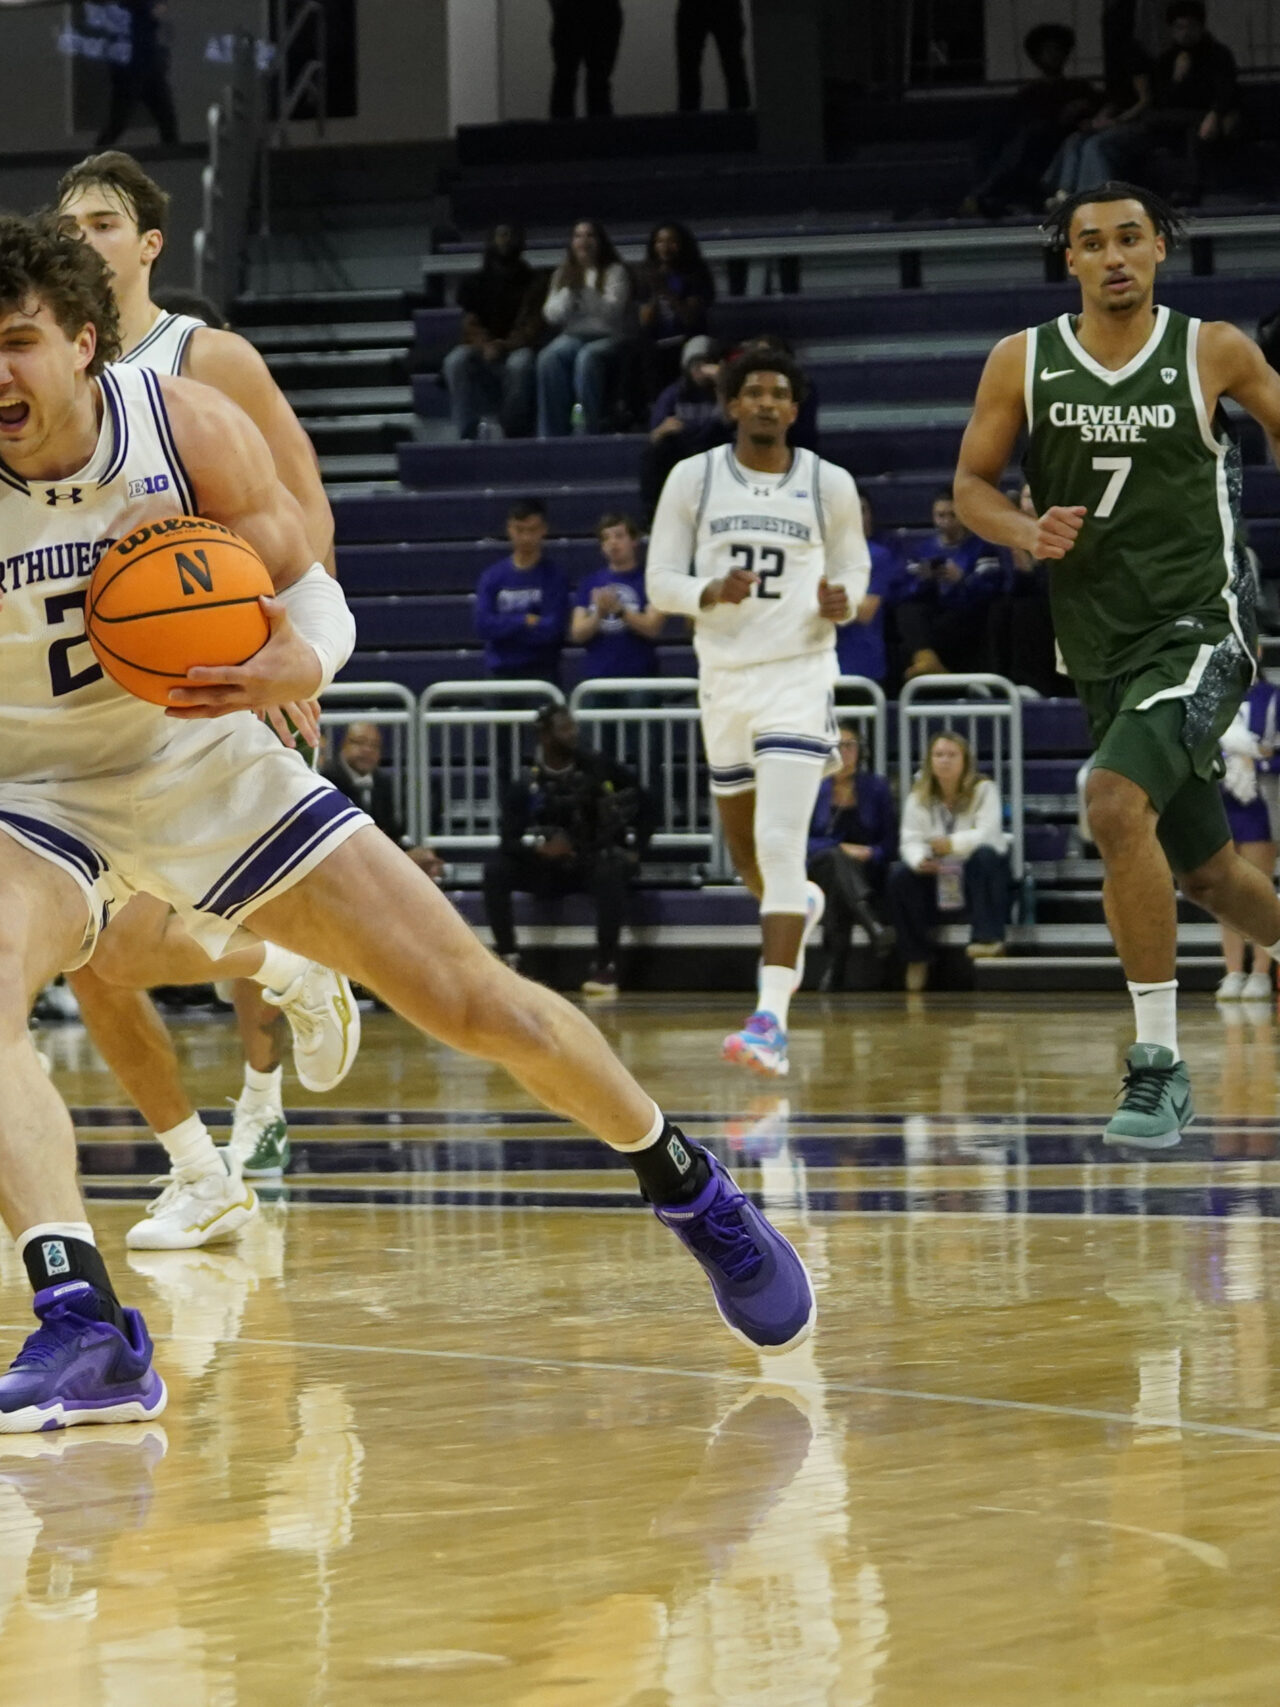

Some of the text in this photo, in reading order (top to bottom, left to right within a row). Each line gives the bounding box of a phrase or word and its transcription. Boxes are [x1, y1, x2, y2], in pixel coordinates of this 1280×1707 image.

[1049, 402, 1176, 428] CLEVELAND
[1080, 424, 1142, 442] STATE
[1092, 457, 1132, 518] 7
[175, 549, 213, 595] N
